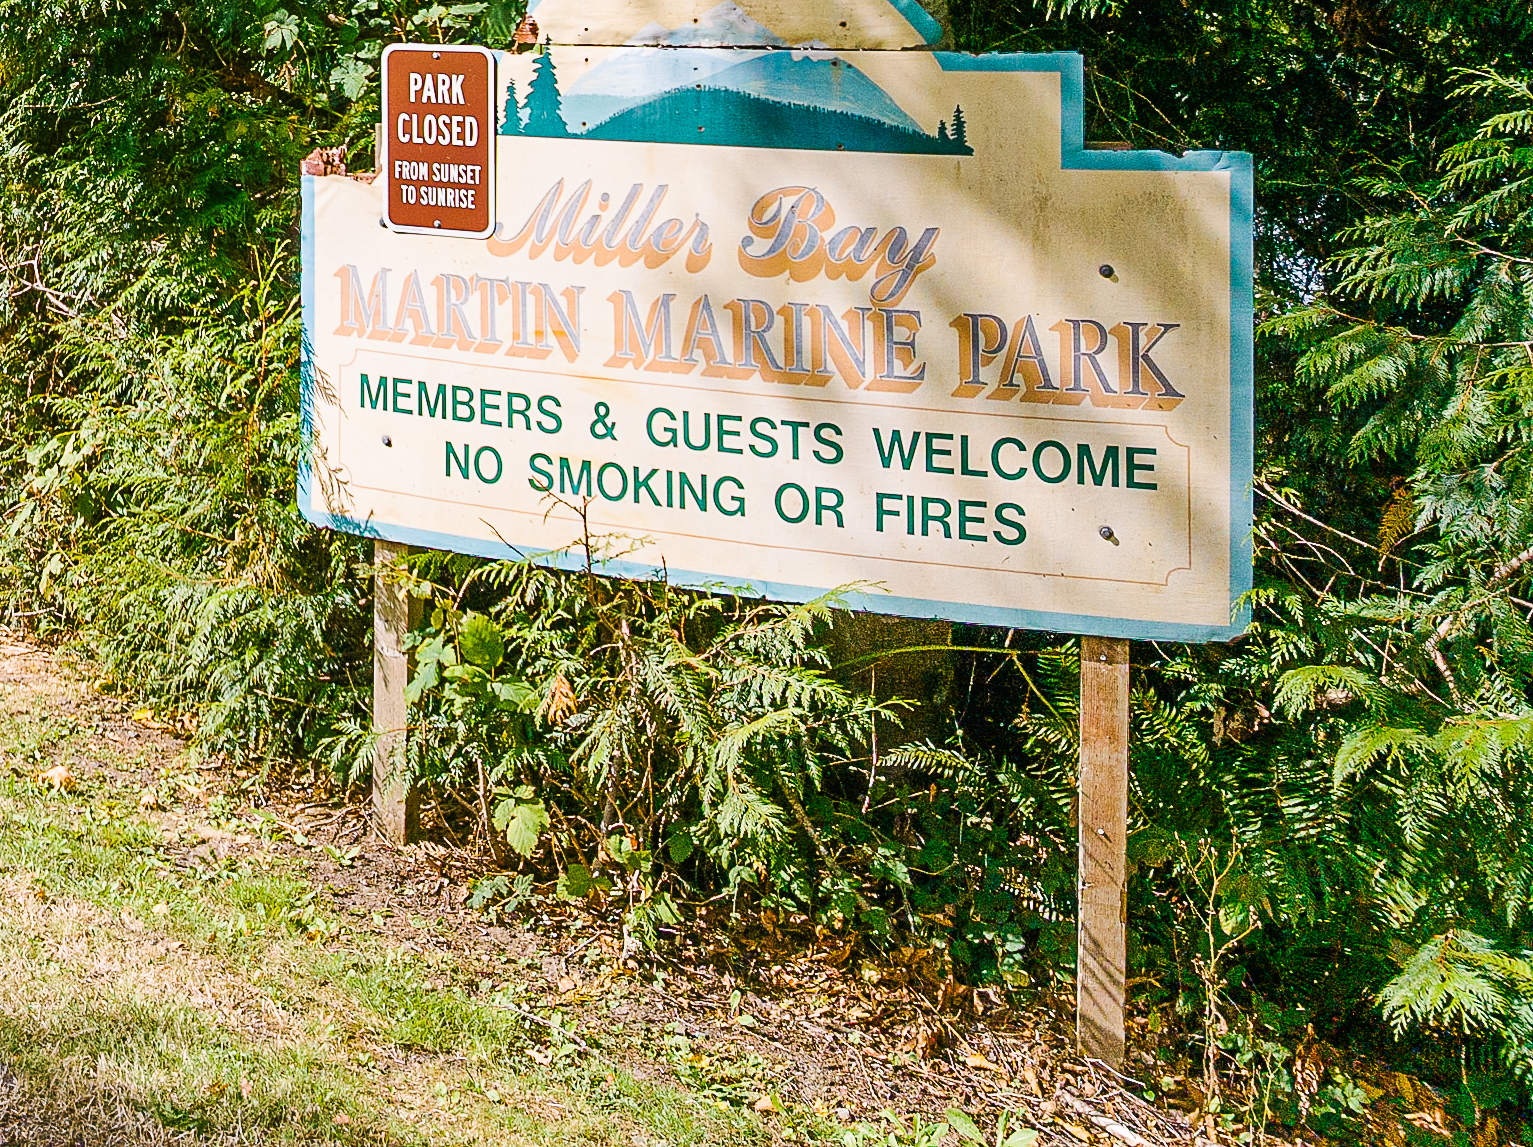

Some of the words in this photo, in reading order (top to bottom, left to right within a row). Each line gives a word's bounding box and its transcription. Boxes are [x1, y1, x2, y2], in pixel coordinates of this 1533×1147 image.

[409, 72, 466, 105] PARK
[397, 113, 479, 147] CLOSED
[394, 160, 429, 181] FROM
[431, 164, 481, 185] SUNSET
[400, 184, 417, 204] TO
[420, 186, 476, 209] SUNRISE
[487, 177, 713, 271] Miller
[738, 185, 940, 307] Bay
[332, 263, 585, 363] MARTIN
[604, 290, 926, 394] MARINE
[950, 313, 1184, 412] PARK
[359, 373, 563, 435] MEMBERS
[590, 401, 618, 441] &
[646, 407, 845, 465] GUESTS
[873, 428, 1159, 492] WELCOME
[445, 441, 504, 484] NO
[528, 451, 745, 518] SMOKING
[775, 482, 845, 529] OR
[875, 492, 1027, 547] FIRES
